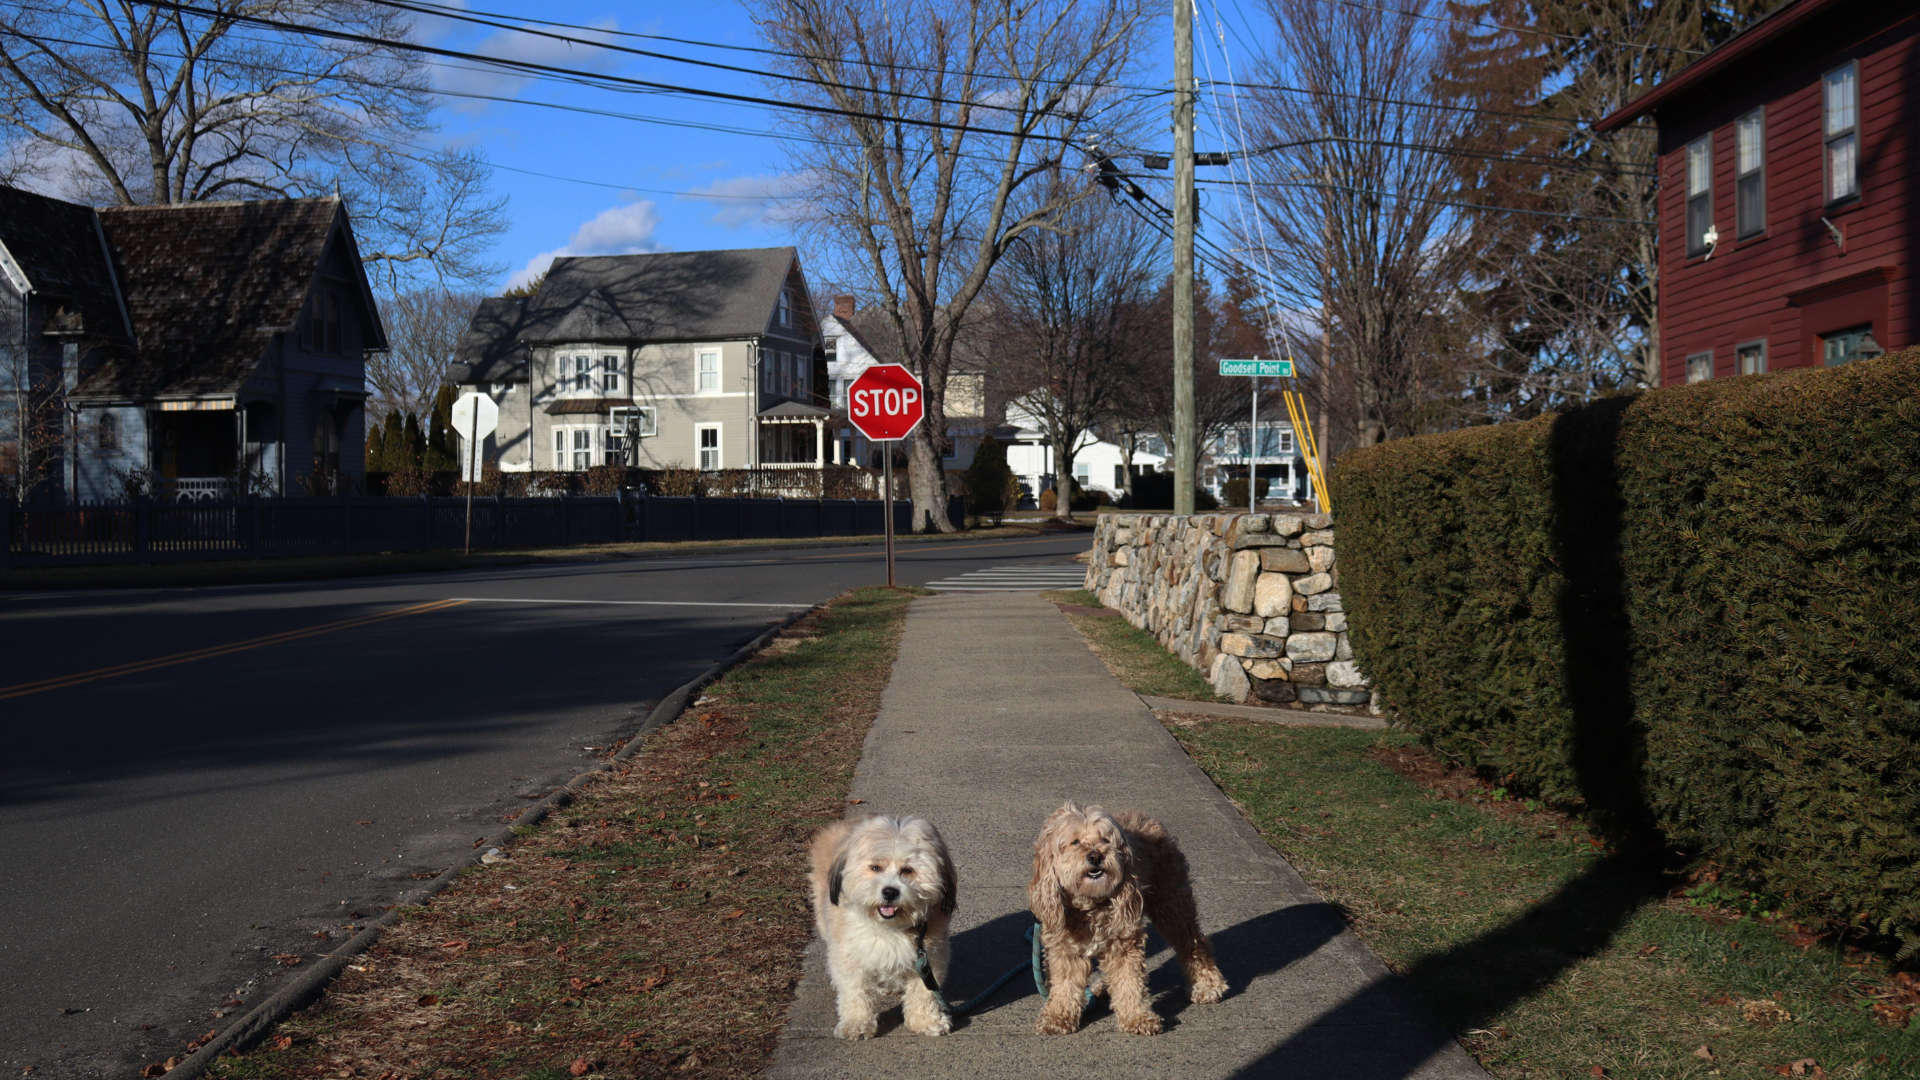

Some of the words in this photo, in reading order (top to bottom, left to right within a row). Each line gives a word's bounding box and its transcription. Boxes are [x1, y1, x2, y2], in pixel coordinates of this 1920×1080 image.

[1223, 362, 1256, 374] Goodsell
[1260, 362, 1280, 374] Point
[854, 388, 918, 417] STOP
